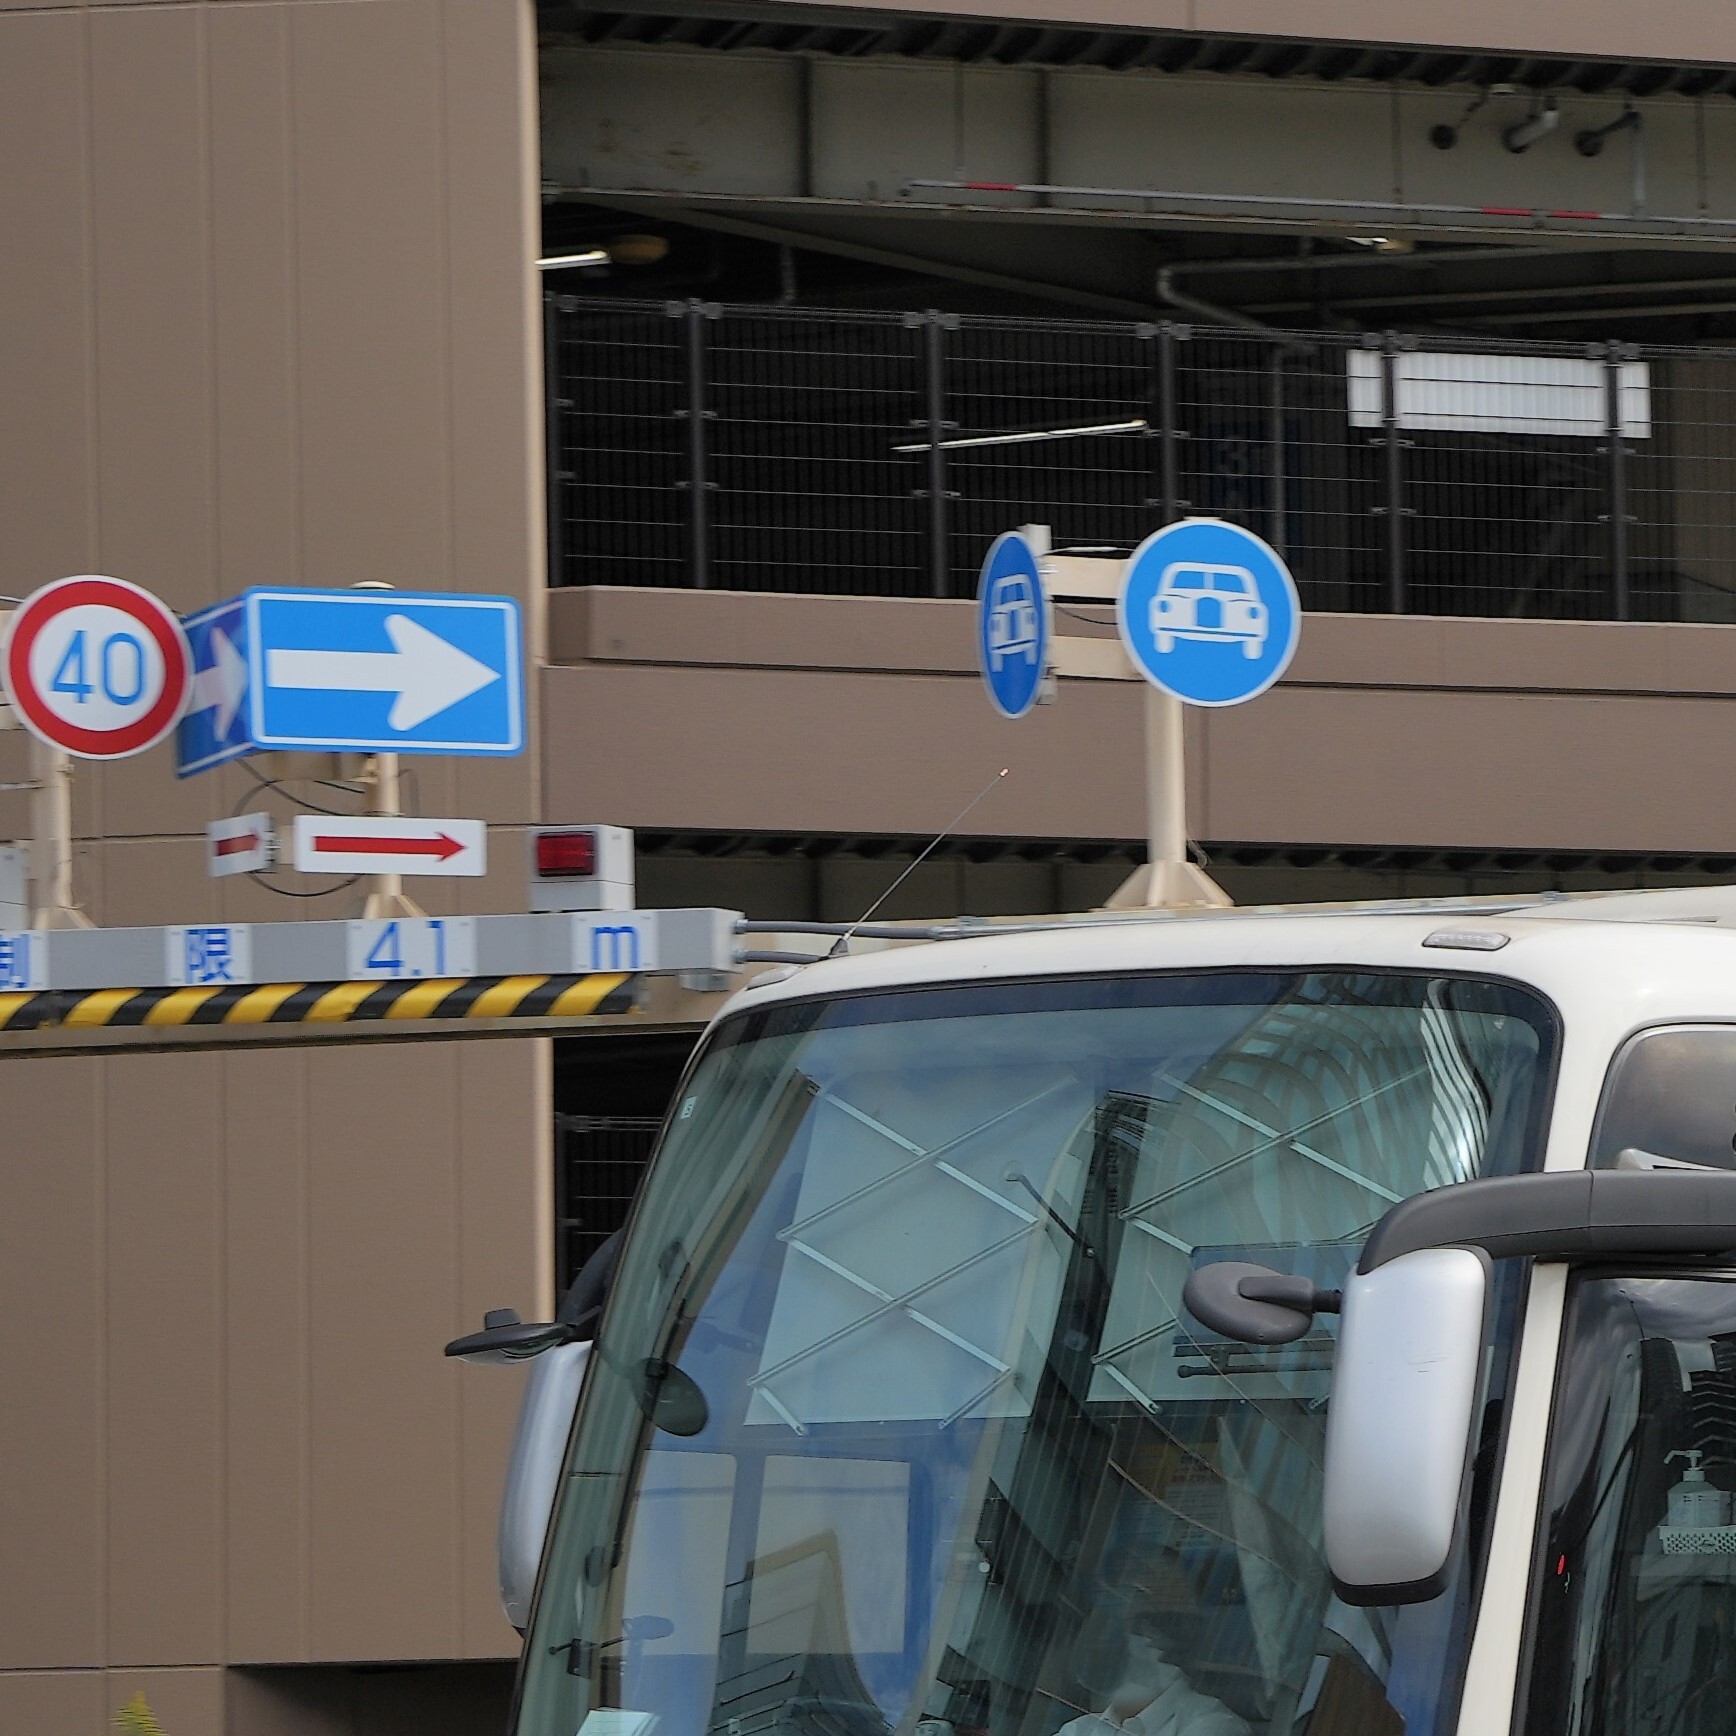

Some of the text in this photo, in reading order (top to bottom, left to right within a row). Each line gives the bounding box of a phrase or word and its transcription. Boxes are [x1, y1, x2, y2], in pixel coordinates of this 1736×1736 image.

[49, 629, 146, 706] 40
[365, 919, 447, 977] 4.1
[590, 924, 640, 970] m
